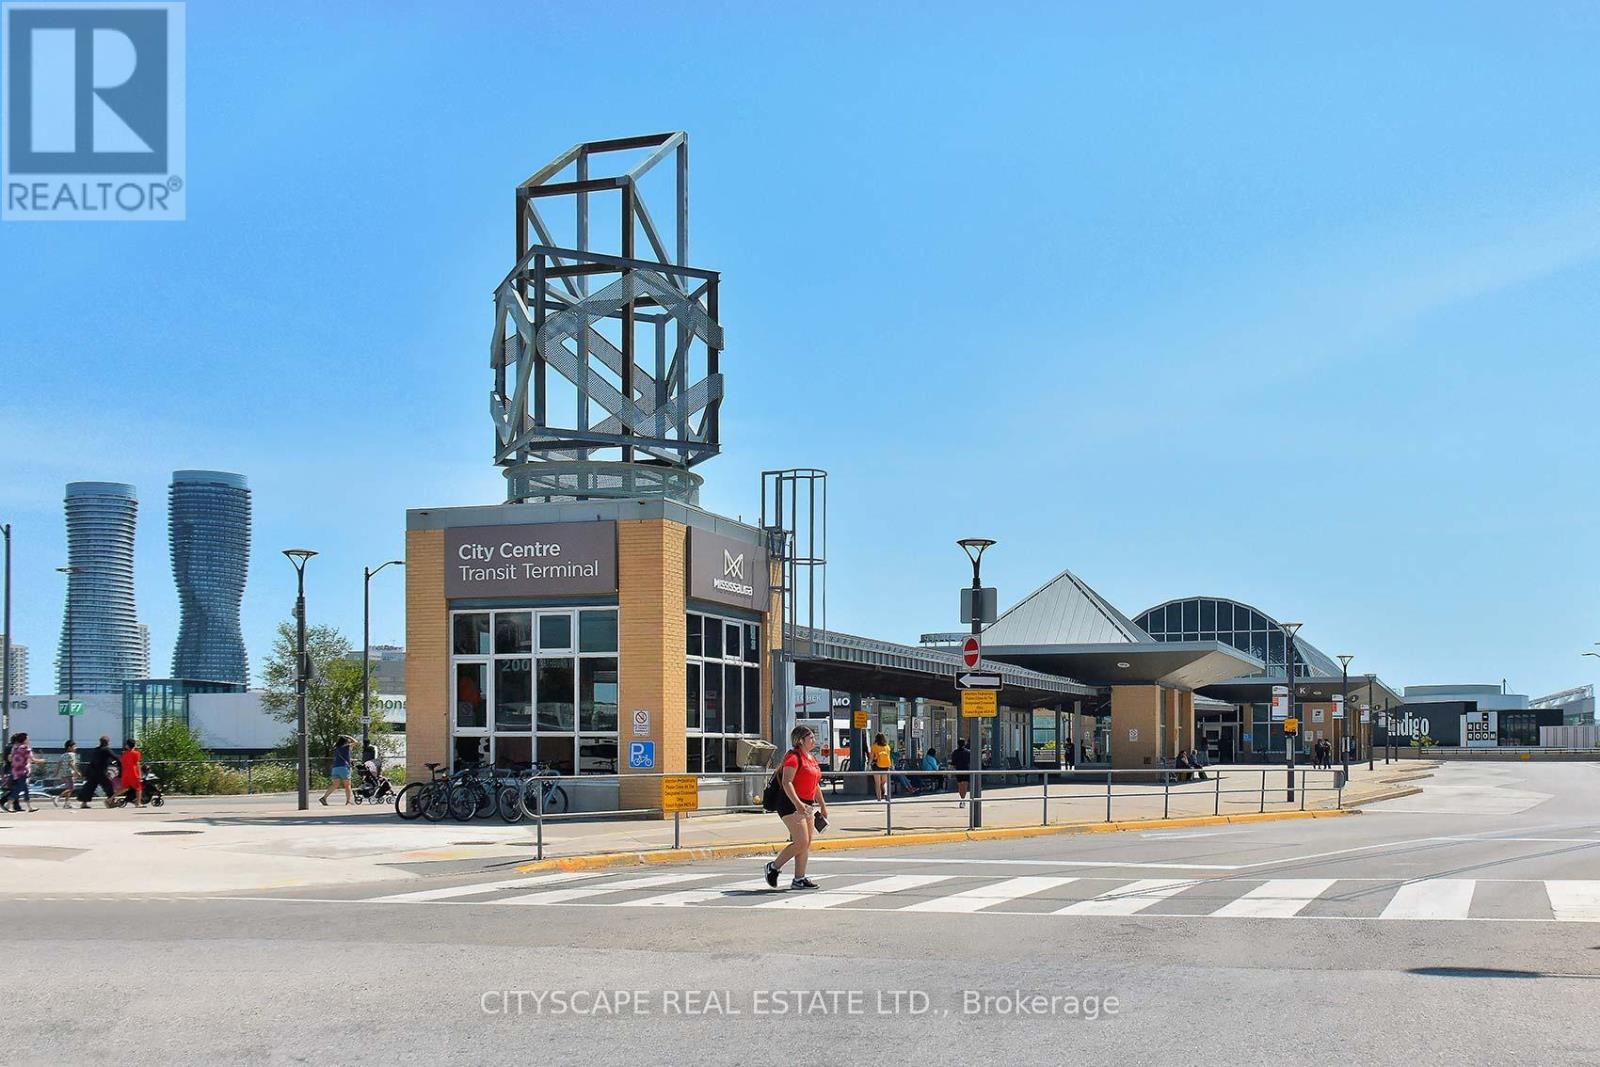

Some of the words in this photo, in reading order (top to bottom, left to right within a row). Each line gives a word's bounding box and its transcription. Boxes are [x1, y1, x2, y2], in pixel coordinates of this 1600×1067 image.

[458, 543, 495, 562] City
[499, 541, 561, 558] Centre
[458, 563, 517, 581] Transit
[522, 559, 599, 579] Terminal
[502, 659, 530, 671] 200
[71, 703, 82, 712] P7
[631, 743, 645, 762] P
